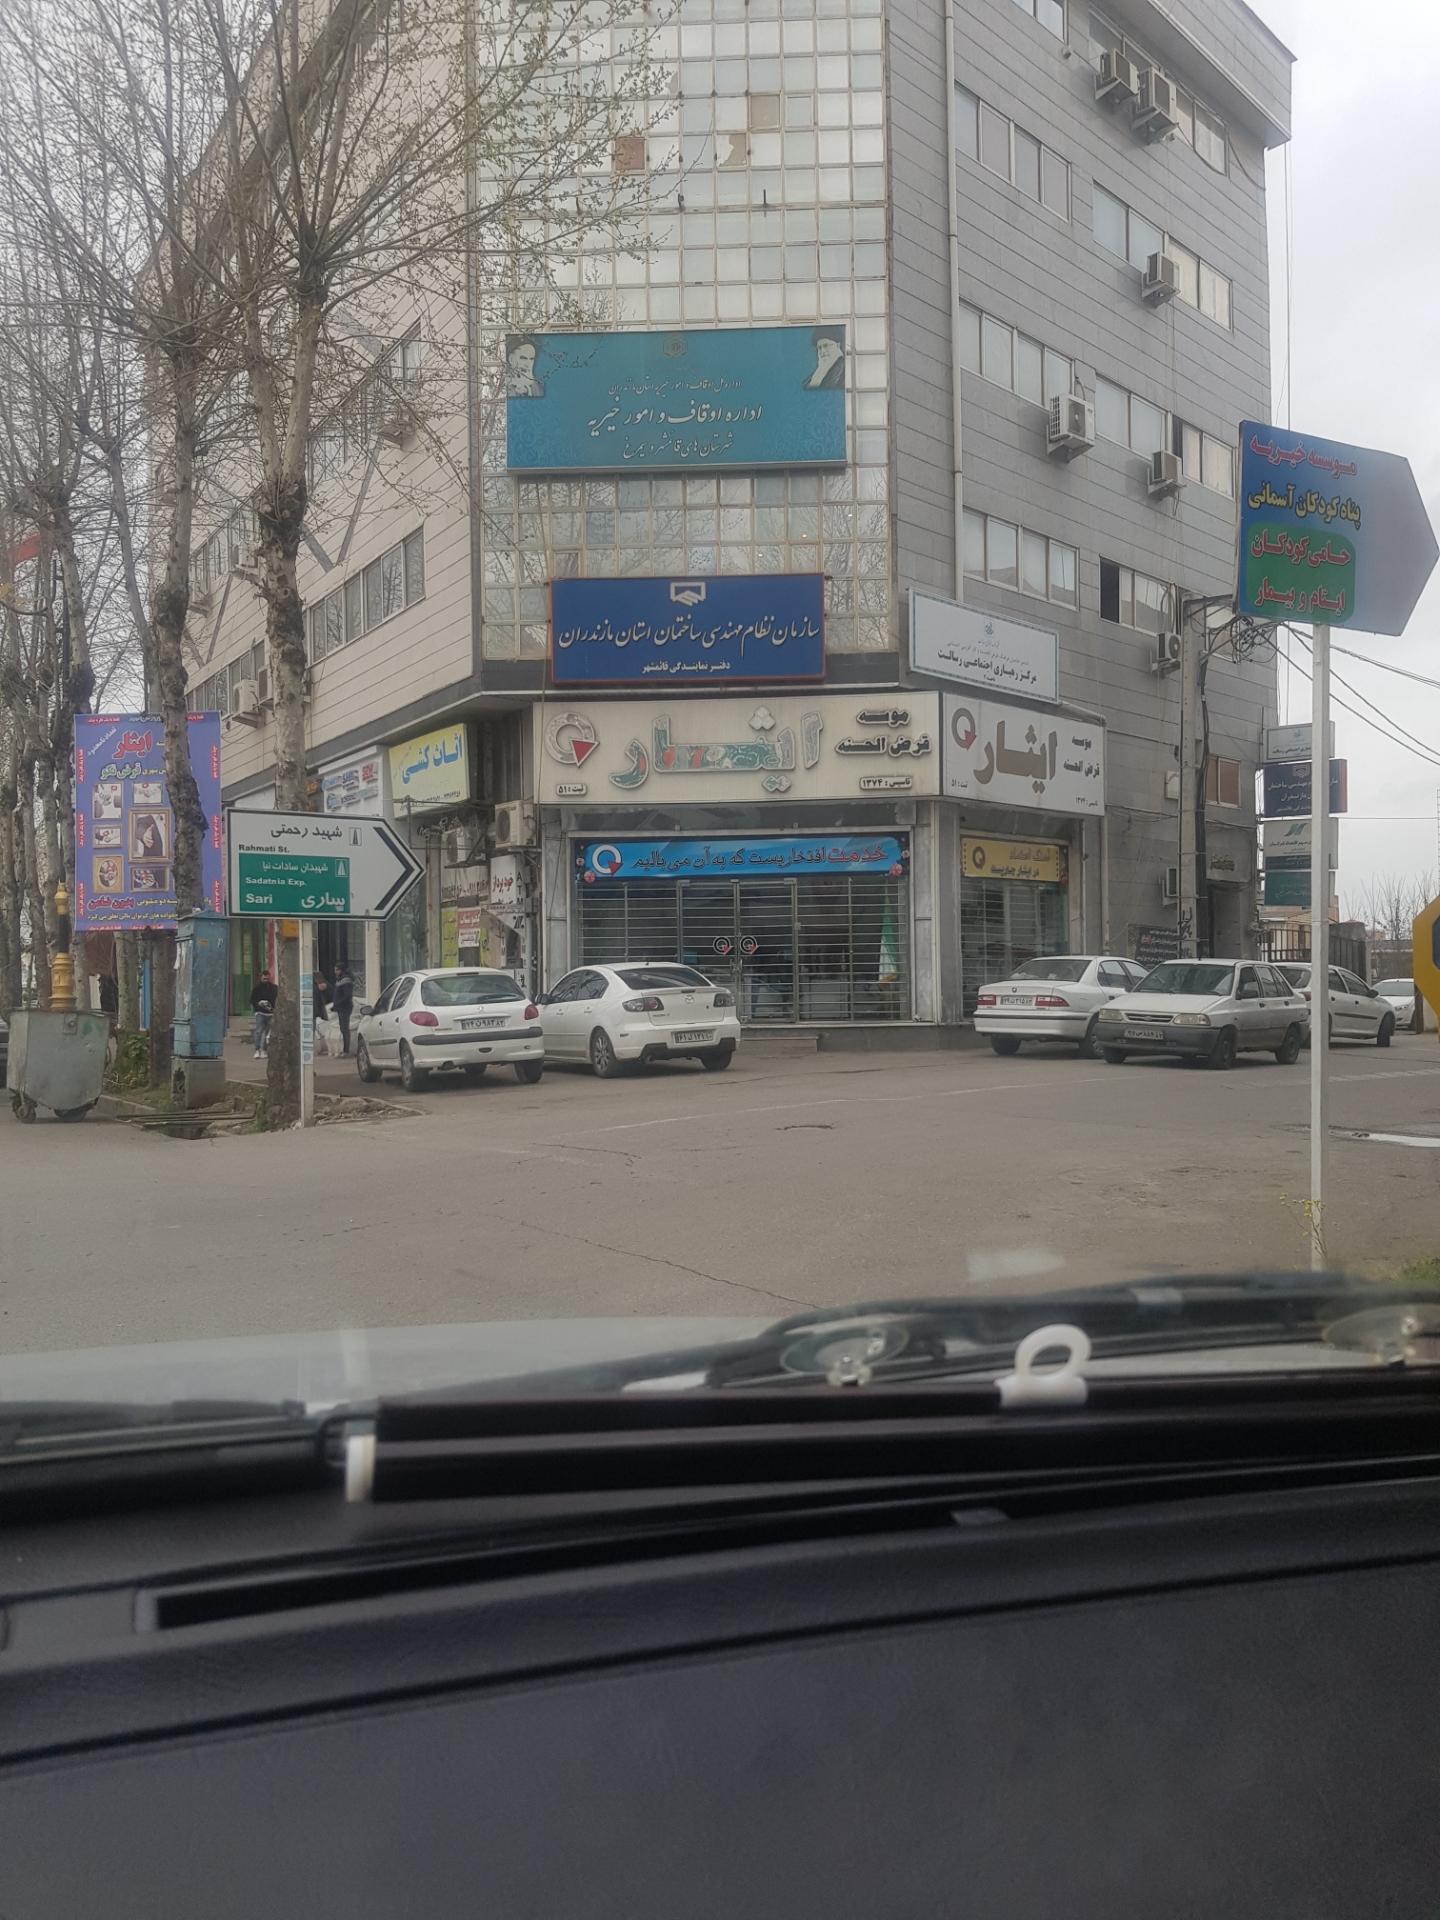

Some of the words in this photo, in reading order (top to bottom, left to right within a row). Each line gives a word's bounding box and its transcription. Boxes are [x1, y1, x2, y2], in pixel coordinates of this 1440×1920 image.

[587, 395, 621, 437] خیریه
[624, 407, 654, 425] امور
[656, 410, 667, 425] و
[667, 398, 723, 424] اوقاف
[725, 404, 763, 423] اداره
[679, 438, 699, 458] های
[700, 431, 734, 458] شهرستان
[1248, 481, 1295, 510] آسمانی
[1295, 491, 1340, 524] کودکان
[1339, 497, 1361, 531] پناه
[1251, 528, 1309, 566] کودکان
[1307, 540, 1351, 567] حامی
[1254, 576, 1296, 609] بیمار
[1298, 592, 1307, 612] و
[1310, 585, 1346, 617] ایتام
[558, 618, 614, 649] مازندران
[614, 620, 652, 648] استان
[653, 613, 702, 647] ساختمان
[701, 620, 744, 649] مهندسی
[740, 614, 776, 658] نظام
[771, 615, 821, 647] سازمان
[669, 659, 709, 674] نمایندگی
[709, 659, 732, 673] دفتر
[1018, 669, 1038, 685] مرکز
[609, 704, 824, 793] ایثار
[836, 735, 887, 753] الحسنه
[889, 733, 931, 757] قرض
[401, 743, 431, 785] کشی
[973, 720, 1059, 795] ایثار
[1063, 758, 1085, 774] الحسنه
[1084, 762, 1101, 779] قرض
[270, 823, 309, 839] رحمتی
[312, 825, 344, 841] شهید
[238, 843, 276, 853] Rahmati
[692, 846, 711, 870] آن
[729, 847, 747, 866] که
[827, 845, 890, 864] خدمت
[271, 861, 299, 873] سادات
[300, 861, 329, 874] شهیدان
[666, 855, 690, 873] می
[711, 855, 727, 871] به
[245, 876, 286, 886] Sadatnia
[245, 892, 274, 905] Sari
